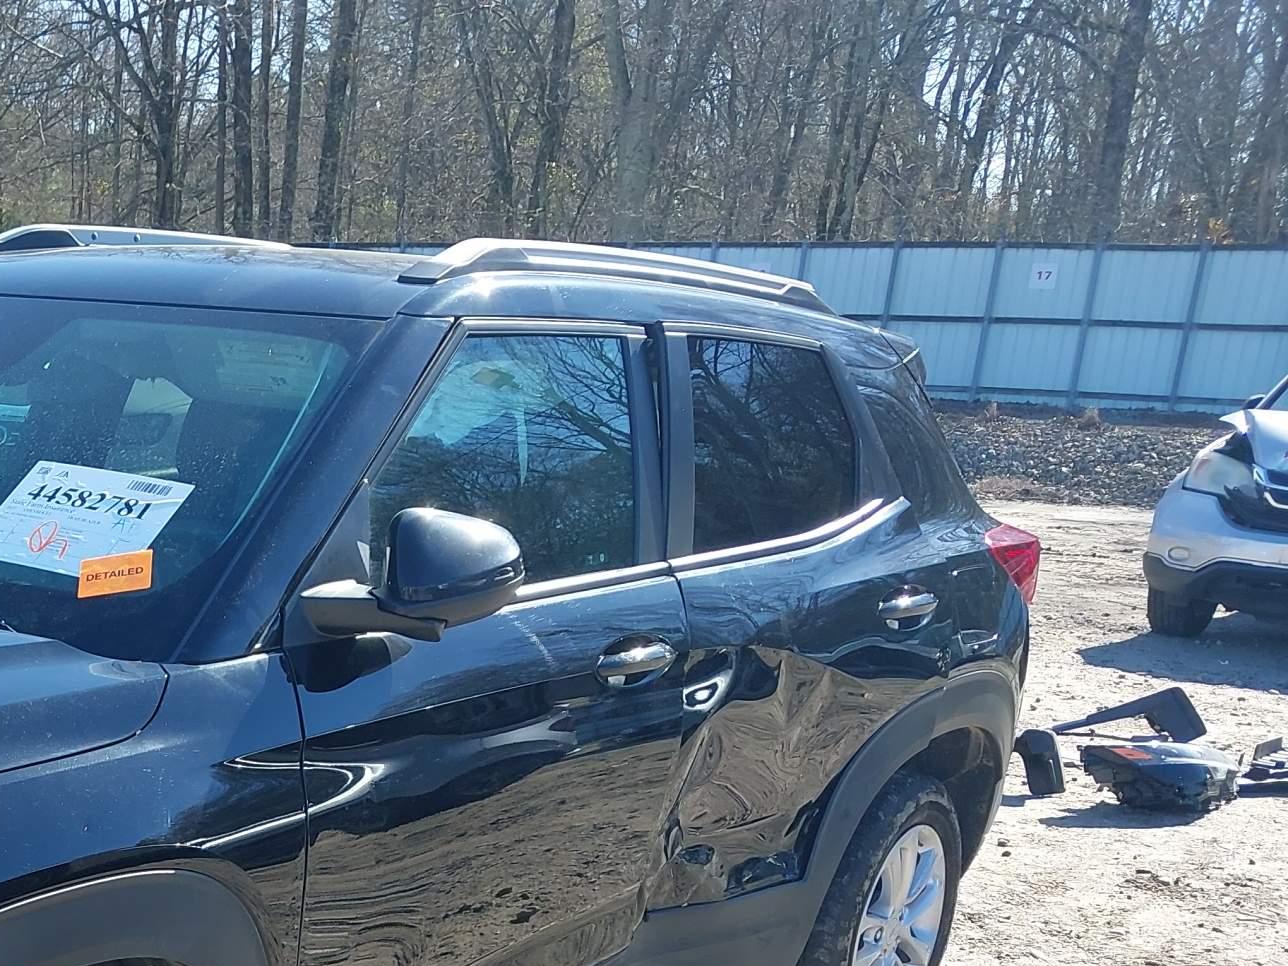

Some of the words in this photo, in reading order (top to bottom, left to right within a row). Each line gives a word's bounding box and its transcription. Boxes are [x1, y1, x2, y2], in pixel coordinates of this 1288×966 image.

[1037, 271, 1052, 281] 17
[27, 483, 152, 520] 44582781
[85, 566, 144, 582] DETAILED
